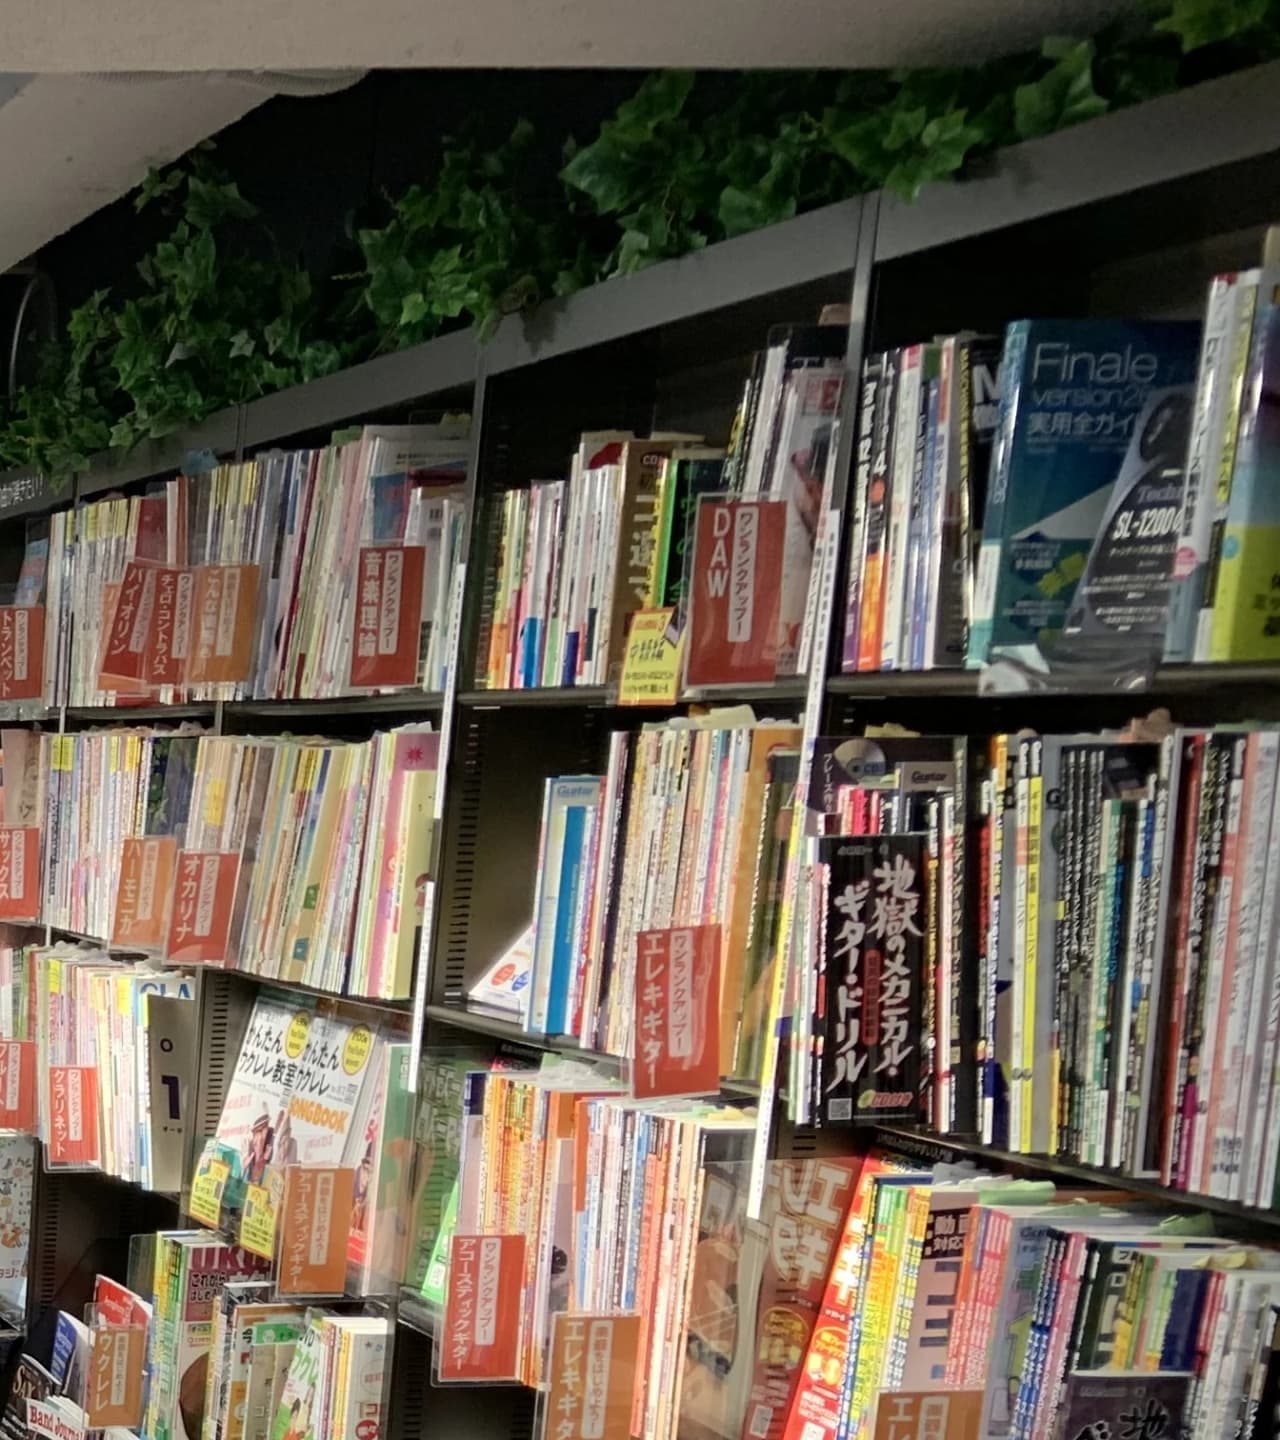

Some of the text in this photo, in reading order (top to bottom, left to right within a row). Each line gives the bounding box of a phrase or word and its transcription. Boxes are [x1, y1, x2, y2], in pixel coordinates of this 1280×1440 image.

[1032, 342, 1159, 385] Finale
[706, 507, 732, 599] DAW
[0, 609, 13, 697] トランペット
[152, 574, 174, 675] チェロ・コントラバス
[357, 553, 381, 658] 音楽理論
[119, 841, 141, 936] ハーモニカ
[175, 855, 201, 943] オカリナ
[639, 933, 664, 1089] エレキギター
[670, 935, 690, 1053] ワンランクアップ！
[826, 880, 870, 1093] ギター・ドリル
[871, 853, 922, 1077] 地獄のメカニカル・
[51, 1069, 67, 1157] クラリネット
[290, 1172, 313, 1287] アコースティックギター
[452, 1239, 476, 1370] アコースティックギター
[29, 1404, 51, 1427] Band
[94, 1331, 113, 1413] ウクレレ
